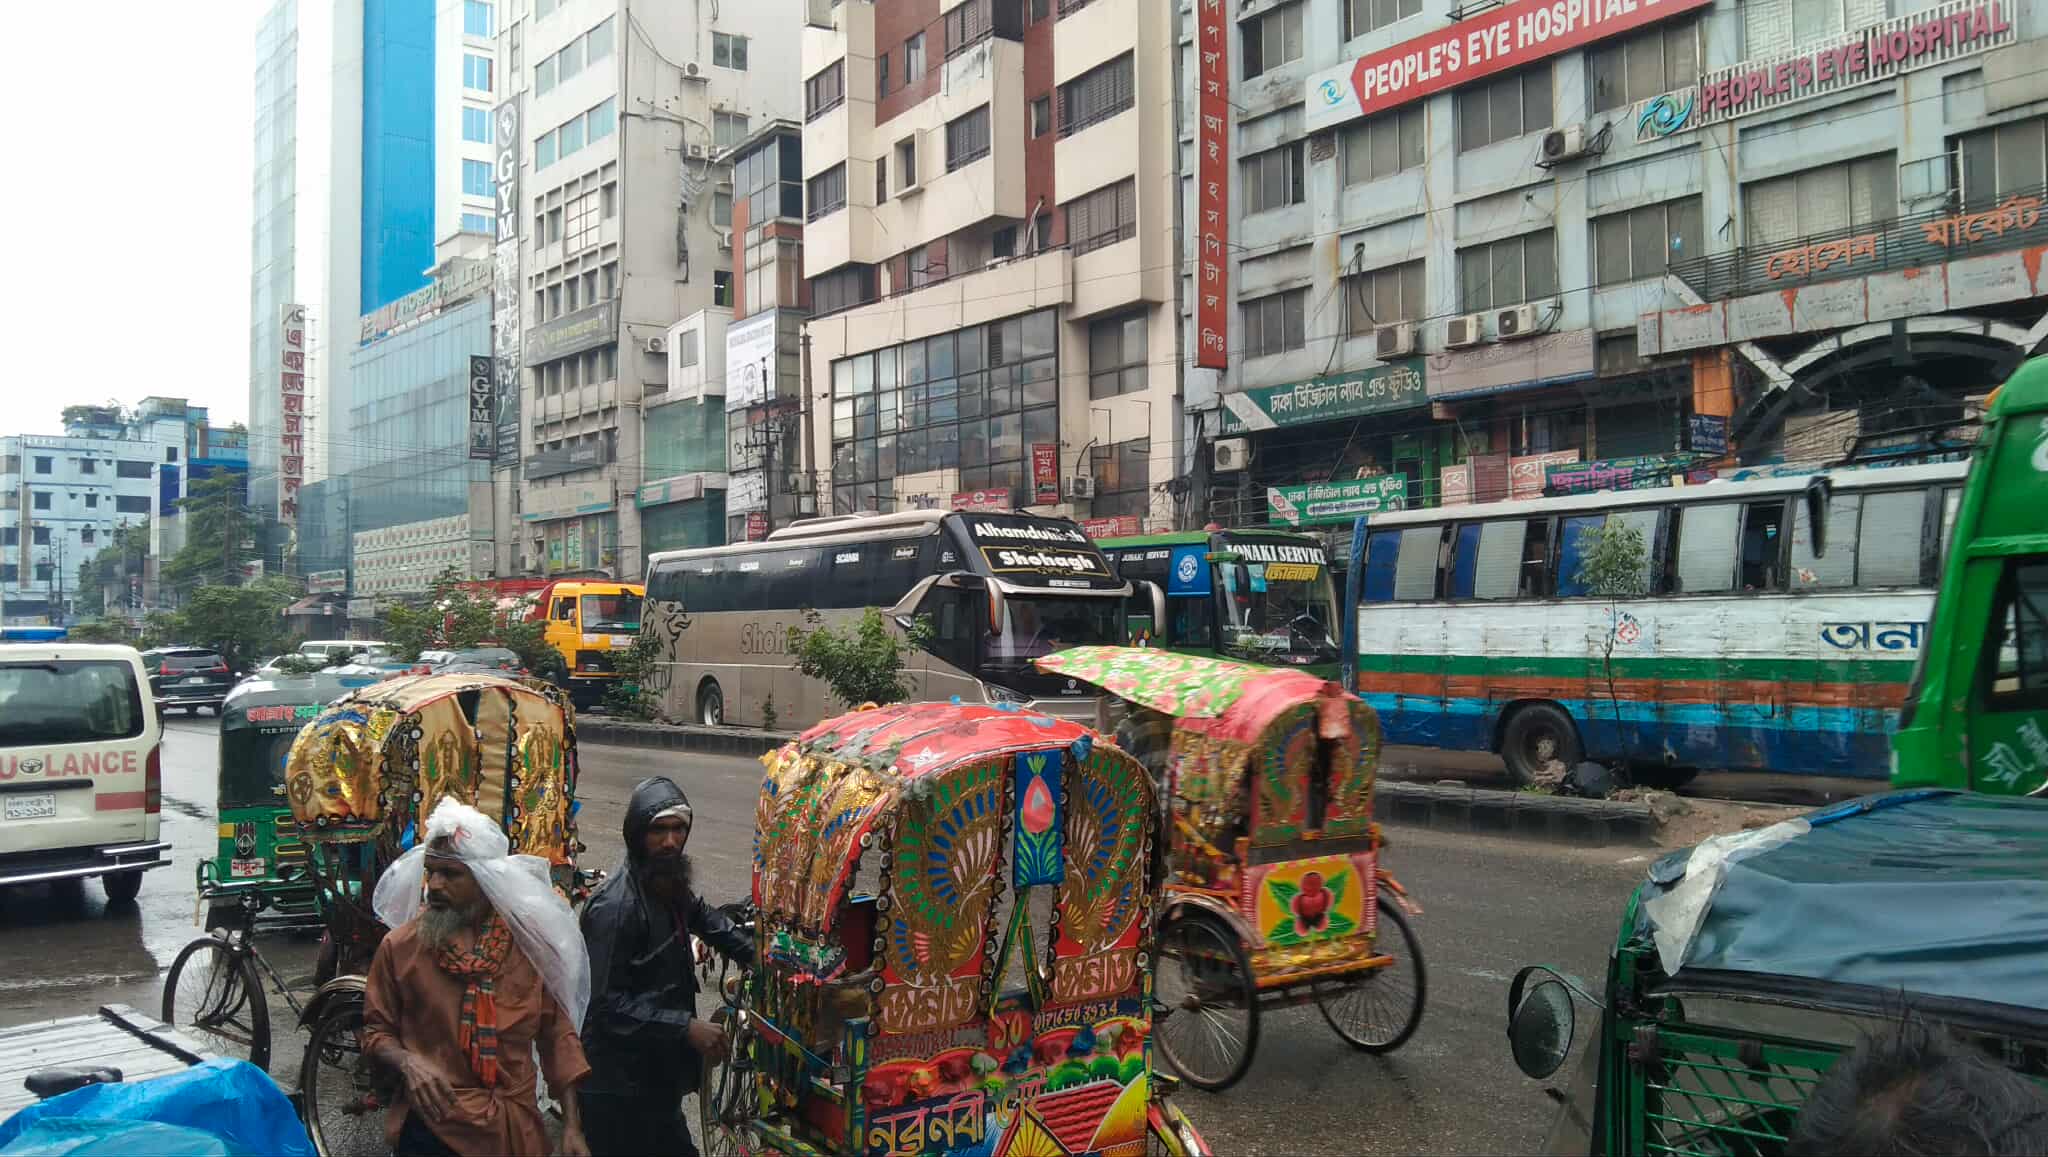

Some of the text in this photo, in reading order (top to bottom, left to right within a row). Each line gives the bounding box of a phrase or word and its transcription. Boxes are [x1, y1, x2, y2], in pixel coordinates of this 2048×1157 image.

[1364, 41, 1461, 99] PEOPLE'S
[1467, 21, 1511, 66] EYE
[1701, 6, 2010, 113] PEOPLE'S EYE HOSPITAL
[497, 149, 515, 242] GYM
[1767, 195, 2043, 280] হোসেন মার্কেট
[402, 274, 458, 315] HOSPITAL
[472, 376, 490, 422] GYM
[1269, 391, 1293, 414] ঢাকা
[999, 550, 1096, 571] Shohagh
